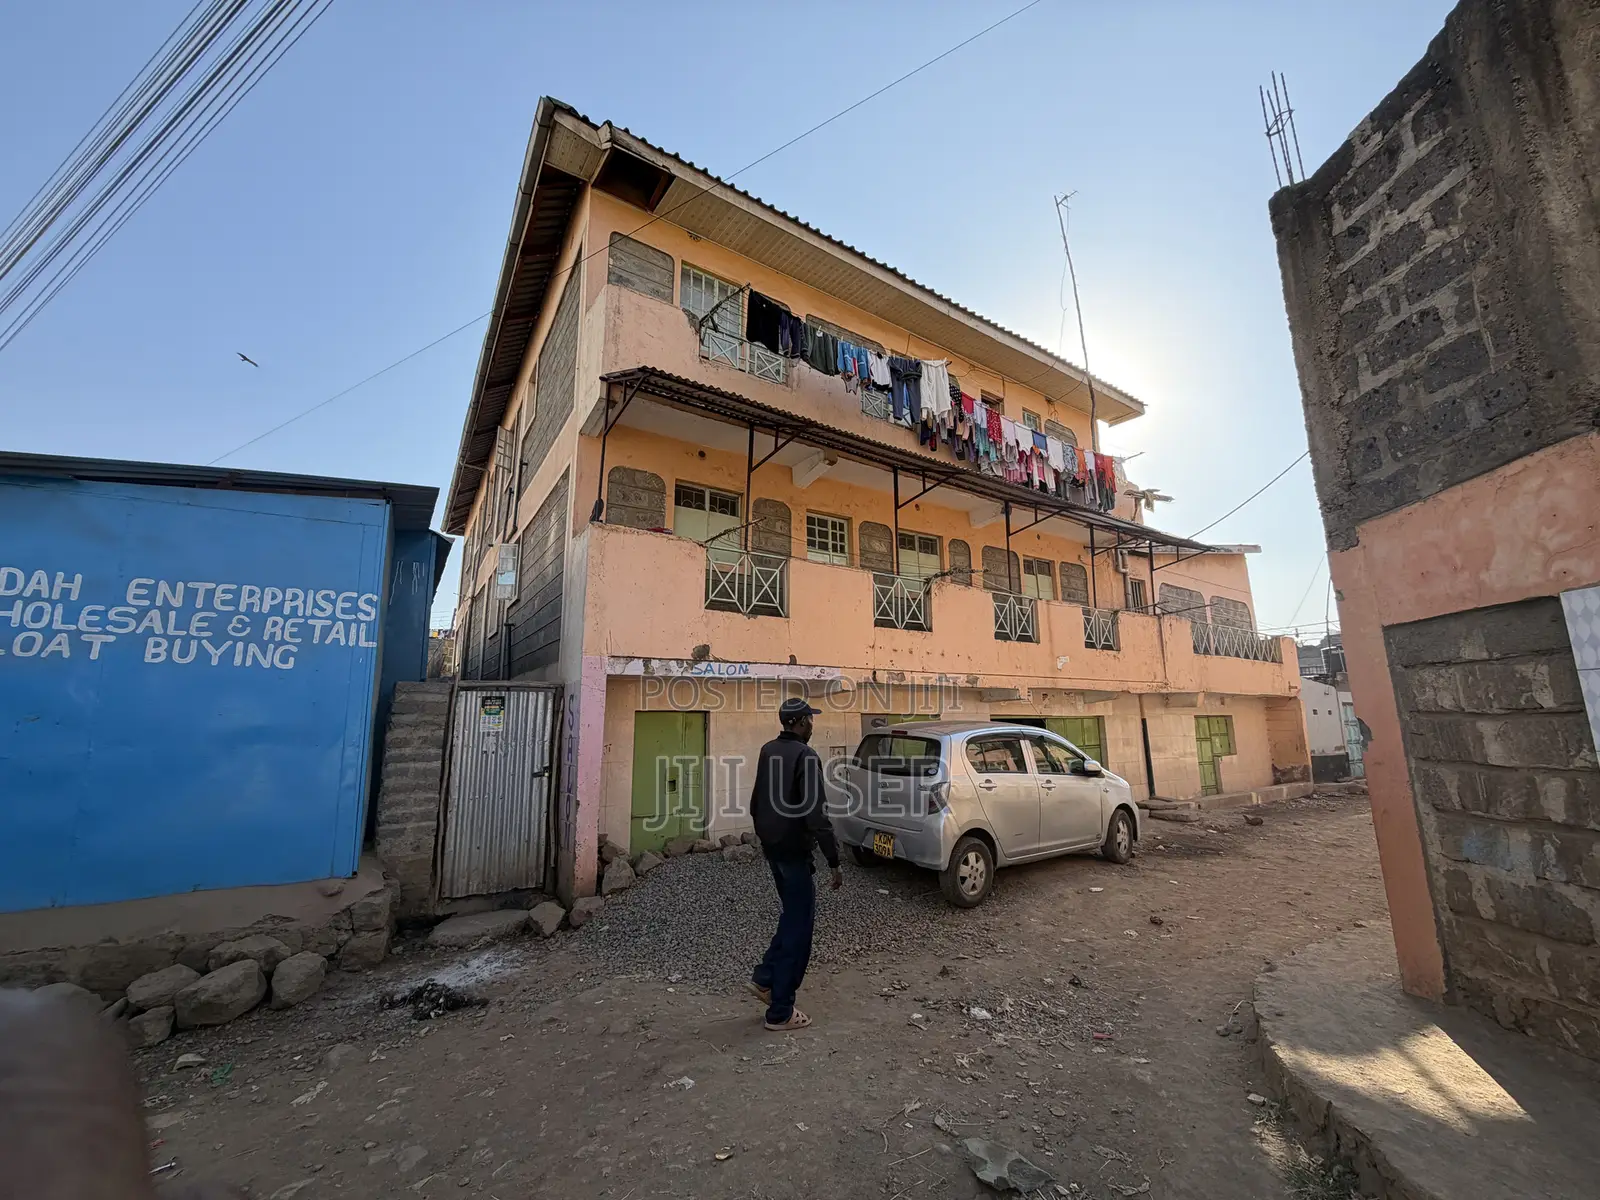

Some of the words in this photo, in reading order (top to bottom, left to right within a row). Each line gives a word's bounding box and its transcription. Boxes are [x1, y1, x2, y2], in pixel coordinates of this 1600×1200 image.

[0, 566, 82, 600] DAH
[126, 577, 378, 621] ENTERPRISES
[227, 614, 251, 636] &
[263, 617, 377, 648] RETAIL
[0, 631, 117, 660] OAT
[144, 636, 299, 670] BUYING
[691, 662, 749, 676] SALON
